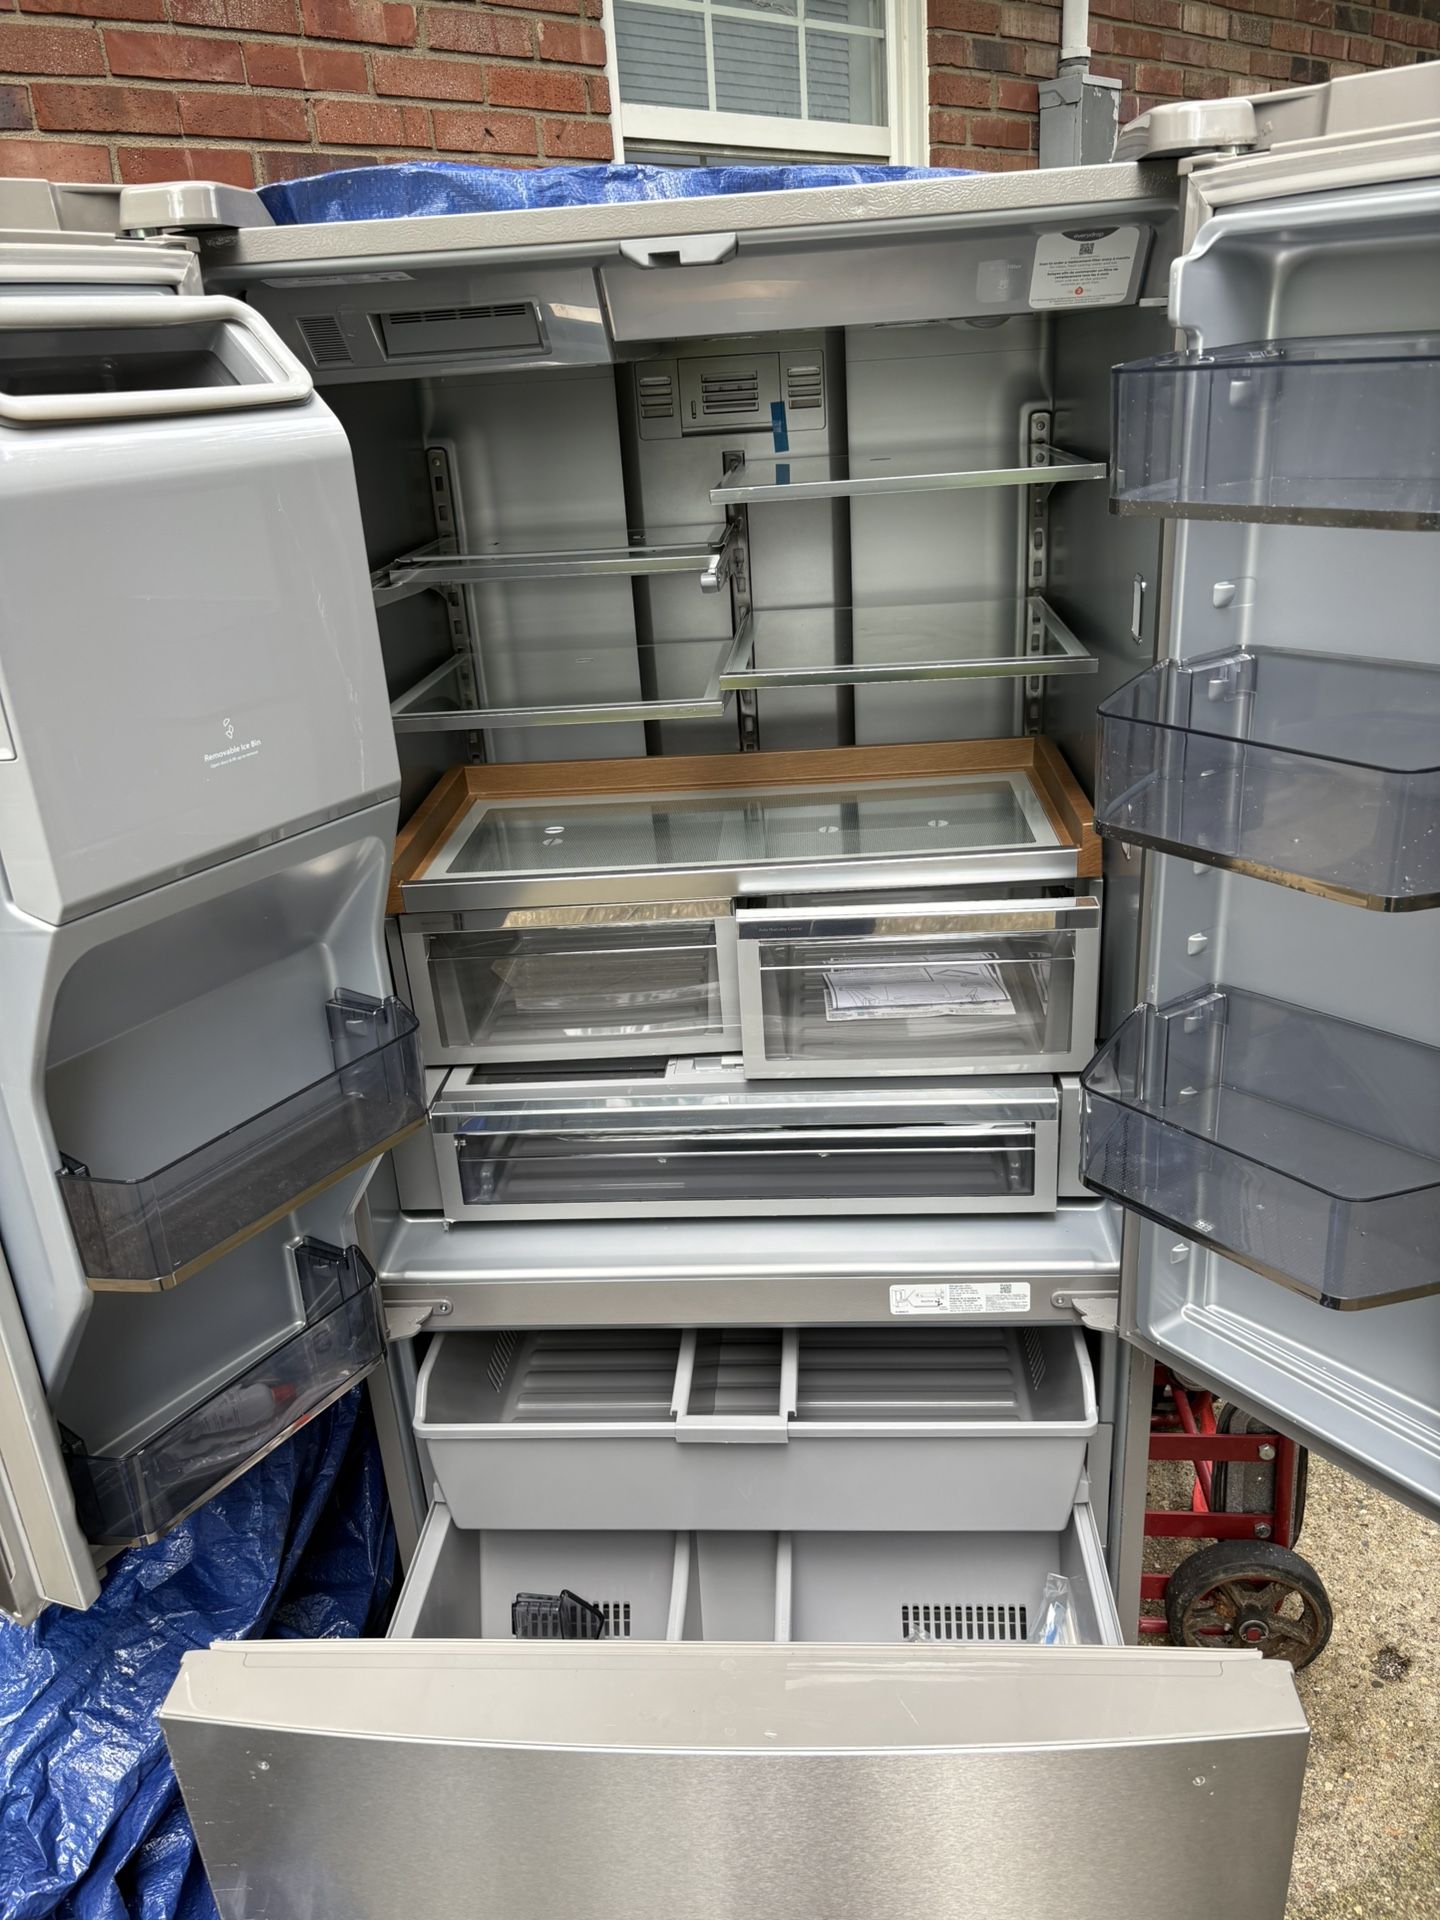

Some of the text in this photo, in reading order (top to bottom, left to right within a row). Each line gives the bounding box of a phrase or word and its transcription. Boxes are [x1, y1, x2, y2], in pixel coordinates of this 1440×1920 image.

[204, 739, 262, 762] Removable Ice Bin
